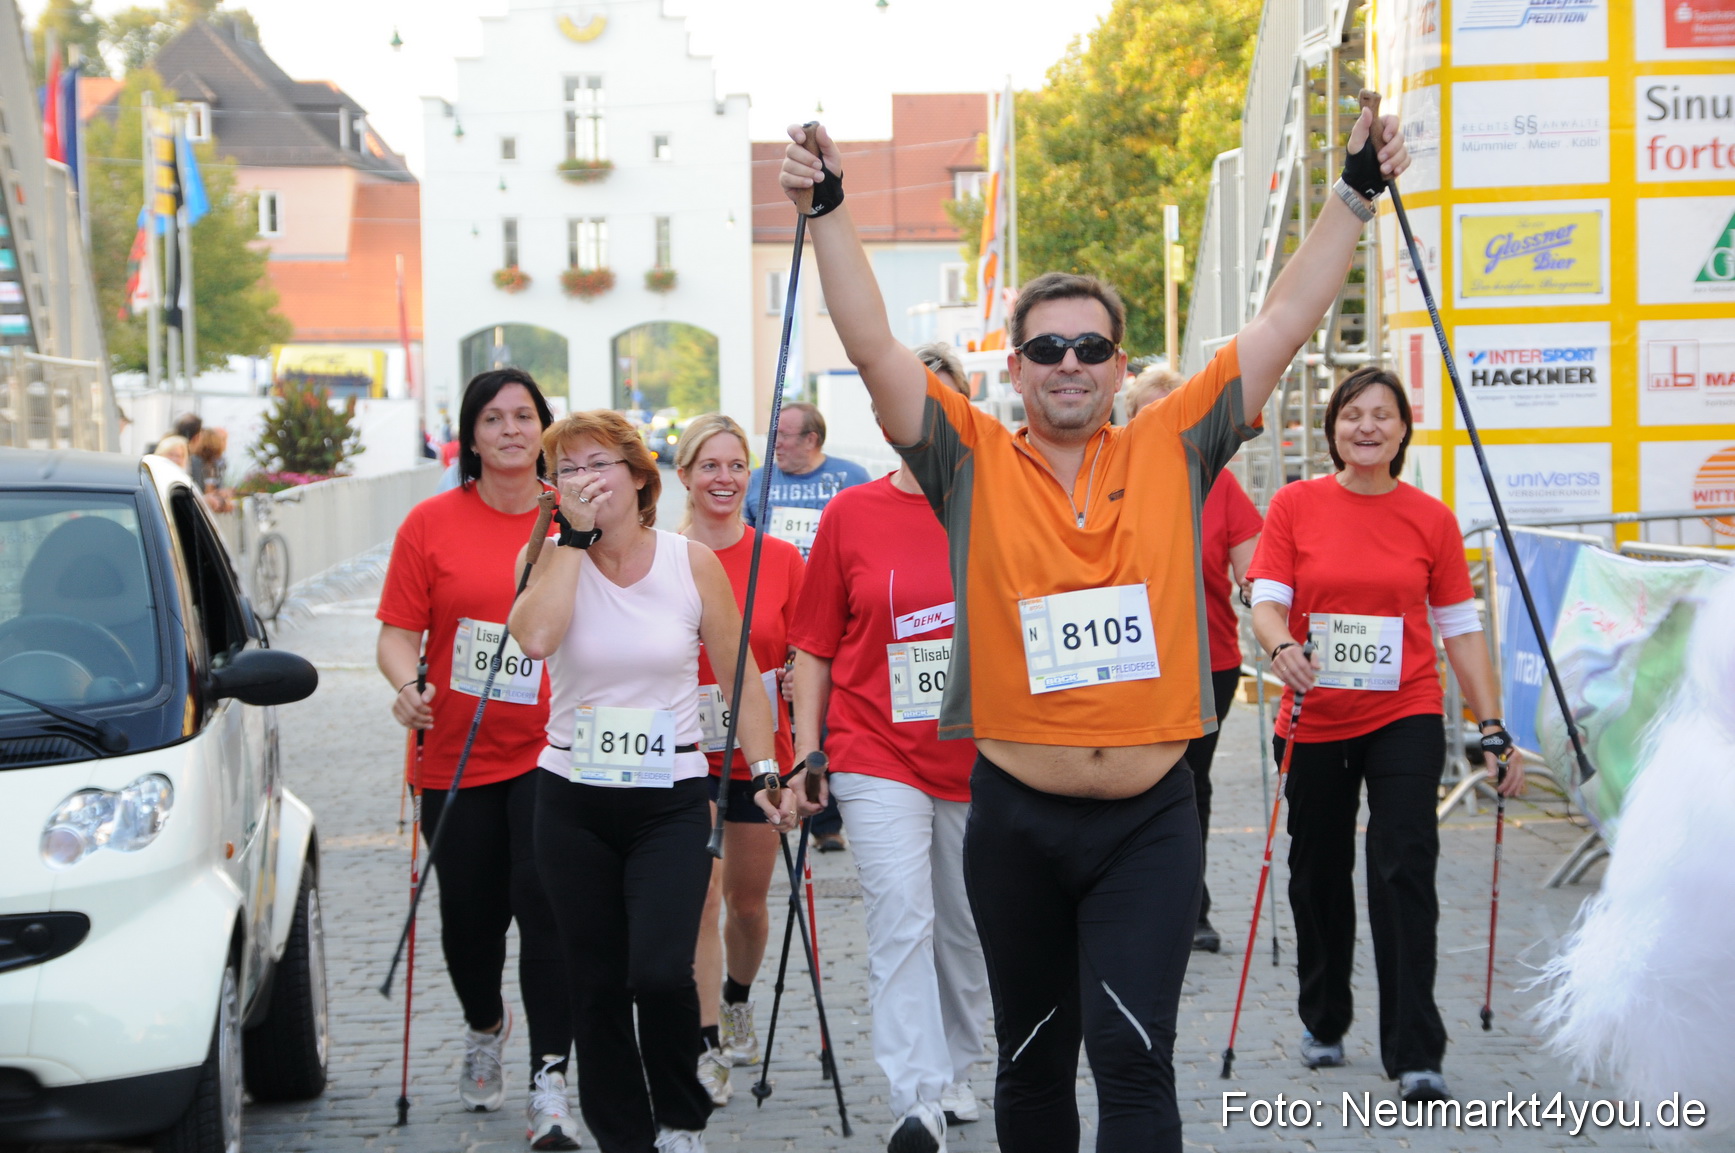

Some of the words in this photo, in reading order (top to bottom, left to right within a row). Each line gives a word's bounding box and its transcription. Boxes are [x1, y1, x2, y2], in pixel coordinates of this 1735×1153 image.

[1528, 138, 1561, 150] Meier
[1483, 223, 1578, 275] Glossner
[1532, 250, 1577, 272] Bier
[1488, 347, 1598, 365] INTERSPORT
[1471, 366, 1598, 387] HACKNER
[1508, 488, 1601, 498] VERSICHERUNGEN
[913, 611, 943, 629] DEHN
[1333, 619, 1367, 635] Maria
[476, 626, 500, 644] Lisa
[1029, 627, 1038, 642] N
[1061, 615, 1143, 651] 8105
[456, 644, 462, 655] N
[1334, 643, 1392, 665] 8062
[1110, 661, 1156, 674] PFLEIDERER
[1514, 650, 1546, 687] max
[894, 673, 901, 685] N
[577, 727, 584, 740] N
[601, 730, 666, 757] 8104
